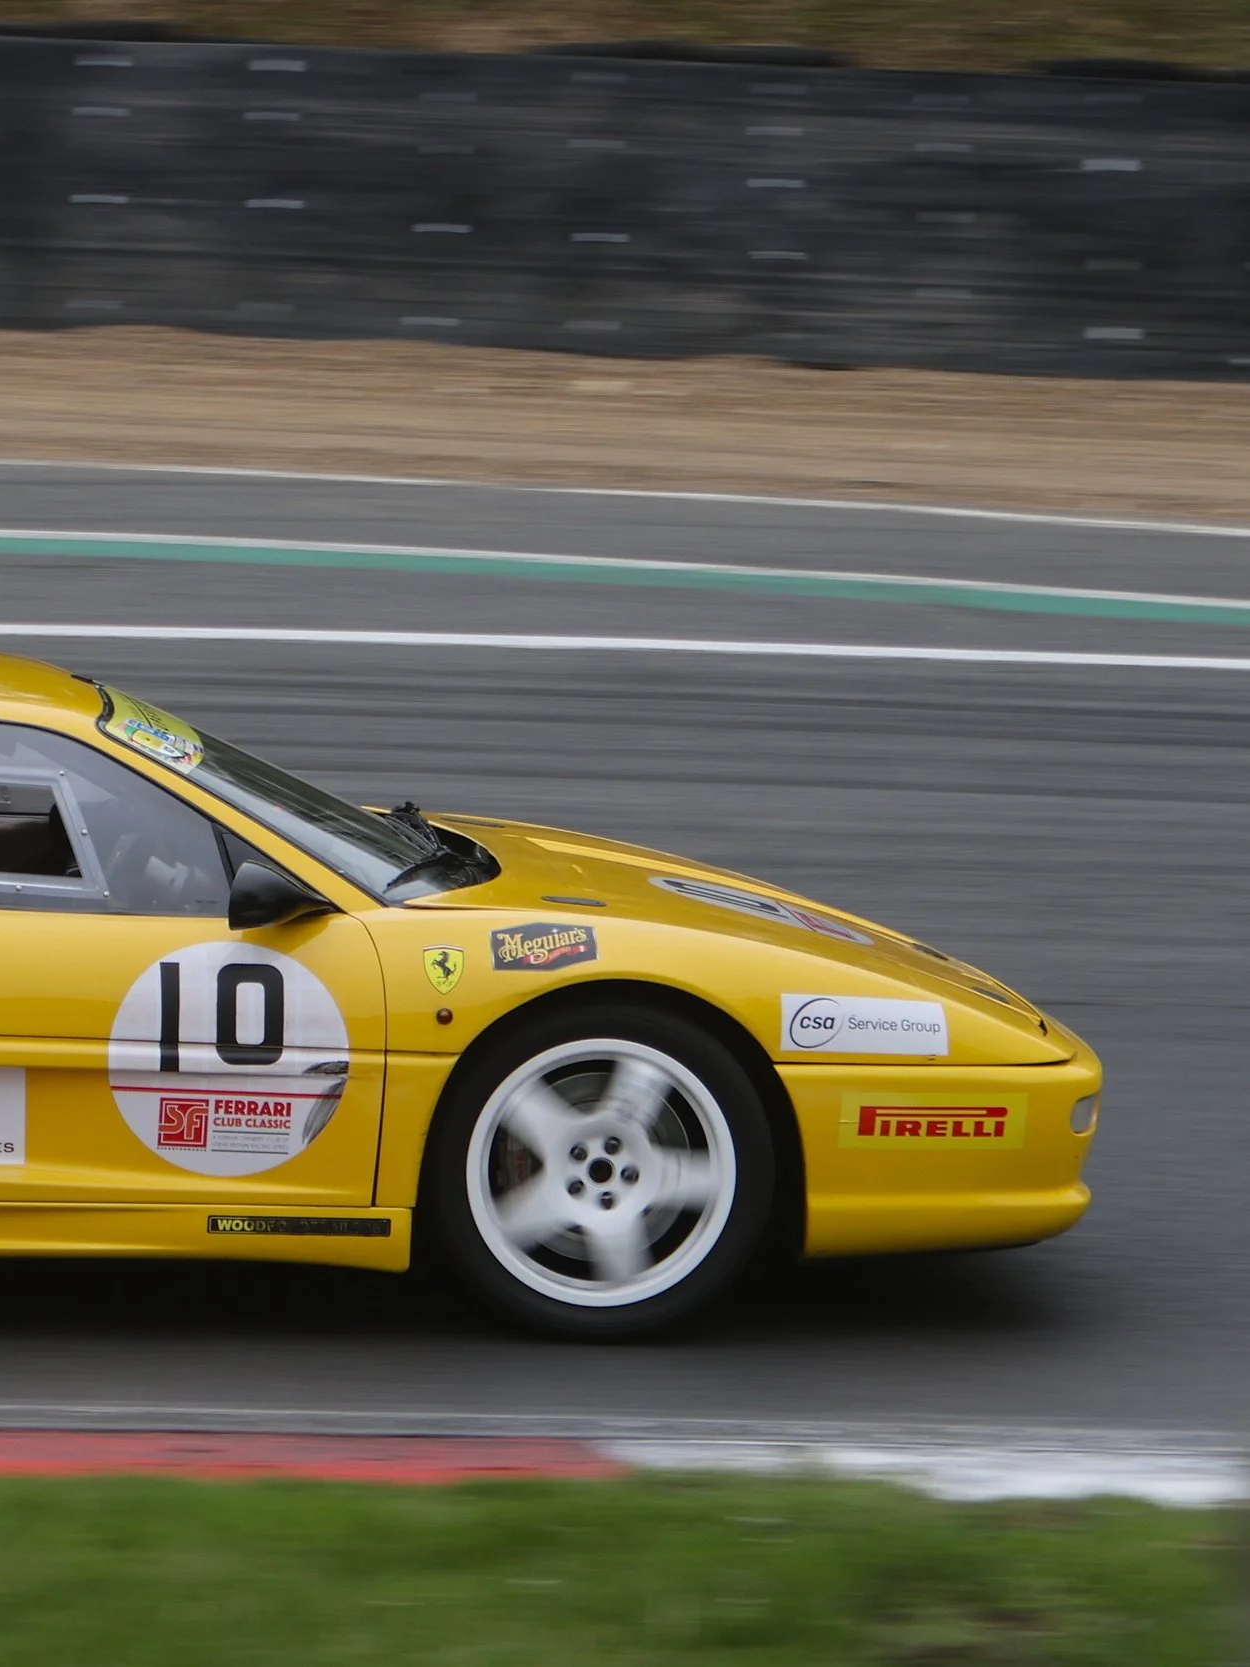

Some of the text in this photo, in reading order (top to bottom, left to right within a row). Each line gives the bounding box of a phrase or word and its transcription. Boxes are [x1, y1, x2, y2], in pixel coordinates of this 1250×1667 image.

[497, 927, 587, 964] Meguiar's
[159, 961, 285, 1073] 10
[800, 1014, 941, 1036] csa Service Group
[214, 1099, 292, 1117] FERRARI
[857, 1105, 1009, 1137] PIRELLI
[213, 1117, 292, 1129] CLUB CLASSIC
